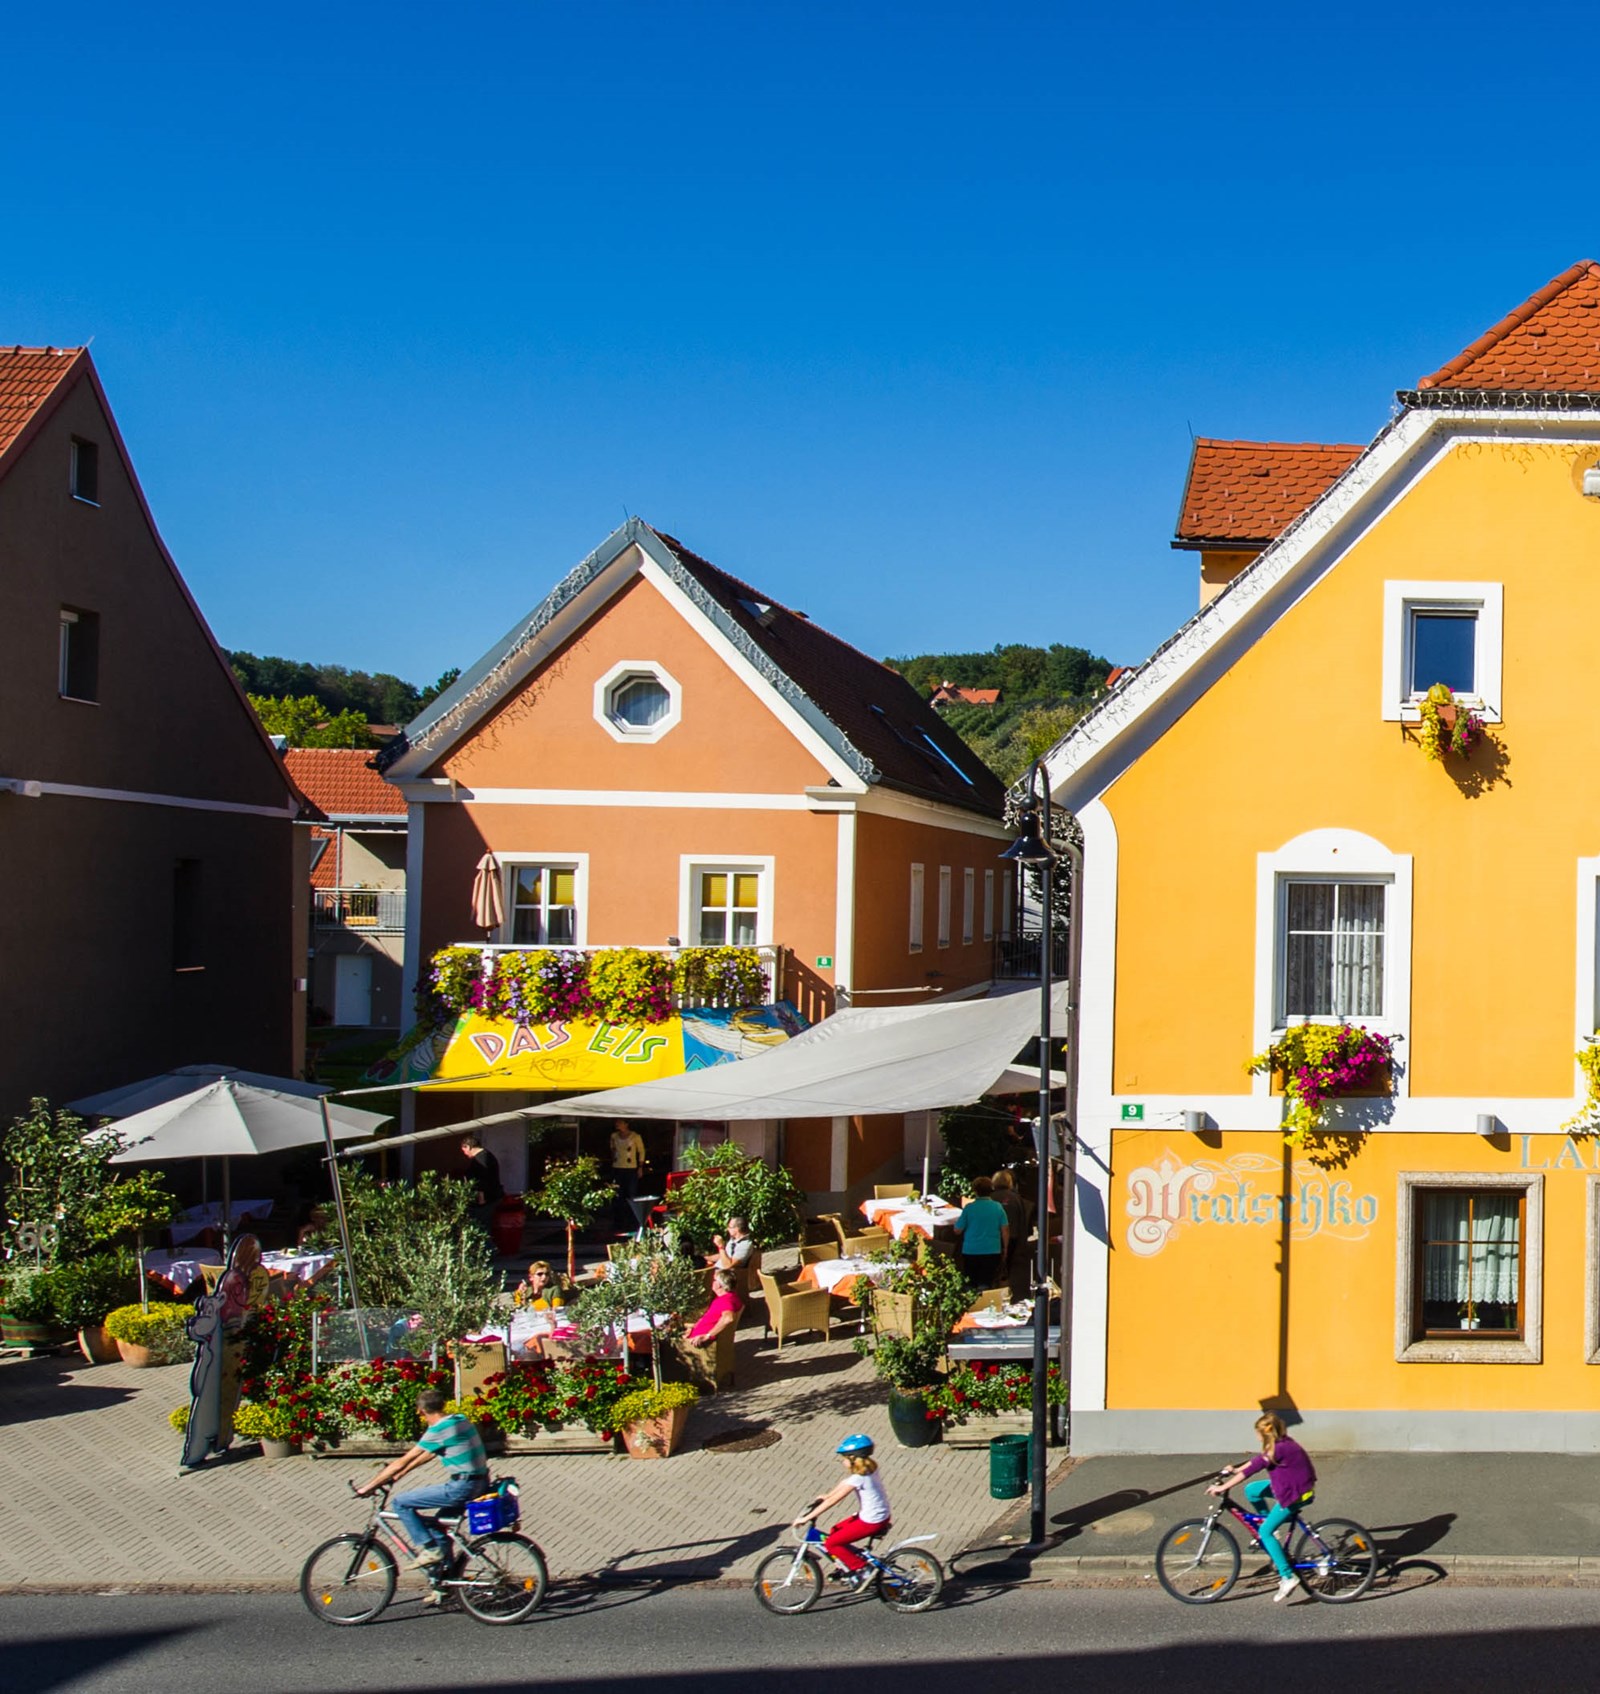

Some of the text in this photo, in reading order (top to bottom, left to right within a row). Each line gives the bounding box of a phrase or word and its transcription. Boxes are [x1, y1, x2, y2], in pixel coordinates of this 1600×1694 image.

[470, 1019, 571, 1064] DAS
[589, 1021, 667, 1063] EIS
[1128, 1105, 1137, 1116] 9
[1126, 1155, 1378, 1258] Wratschko
